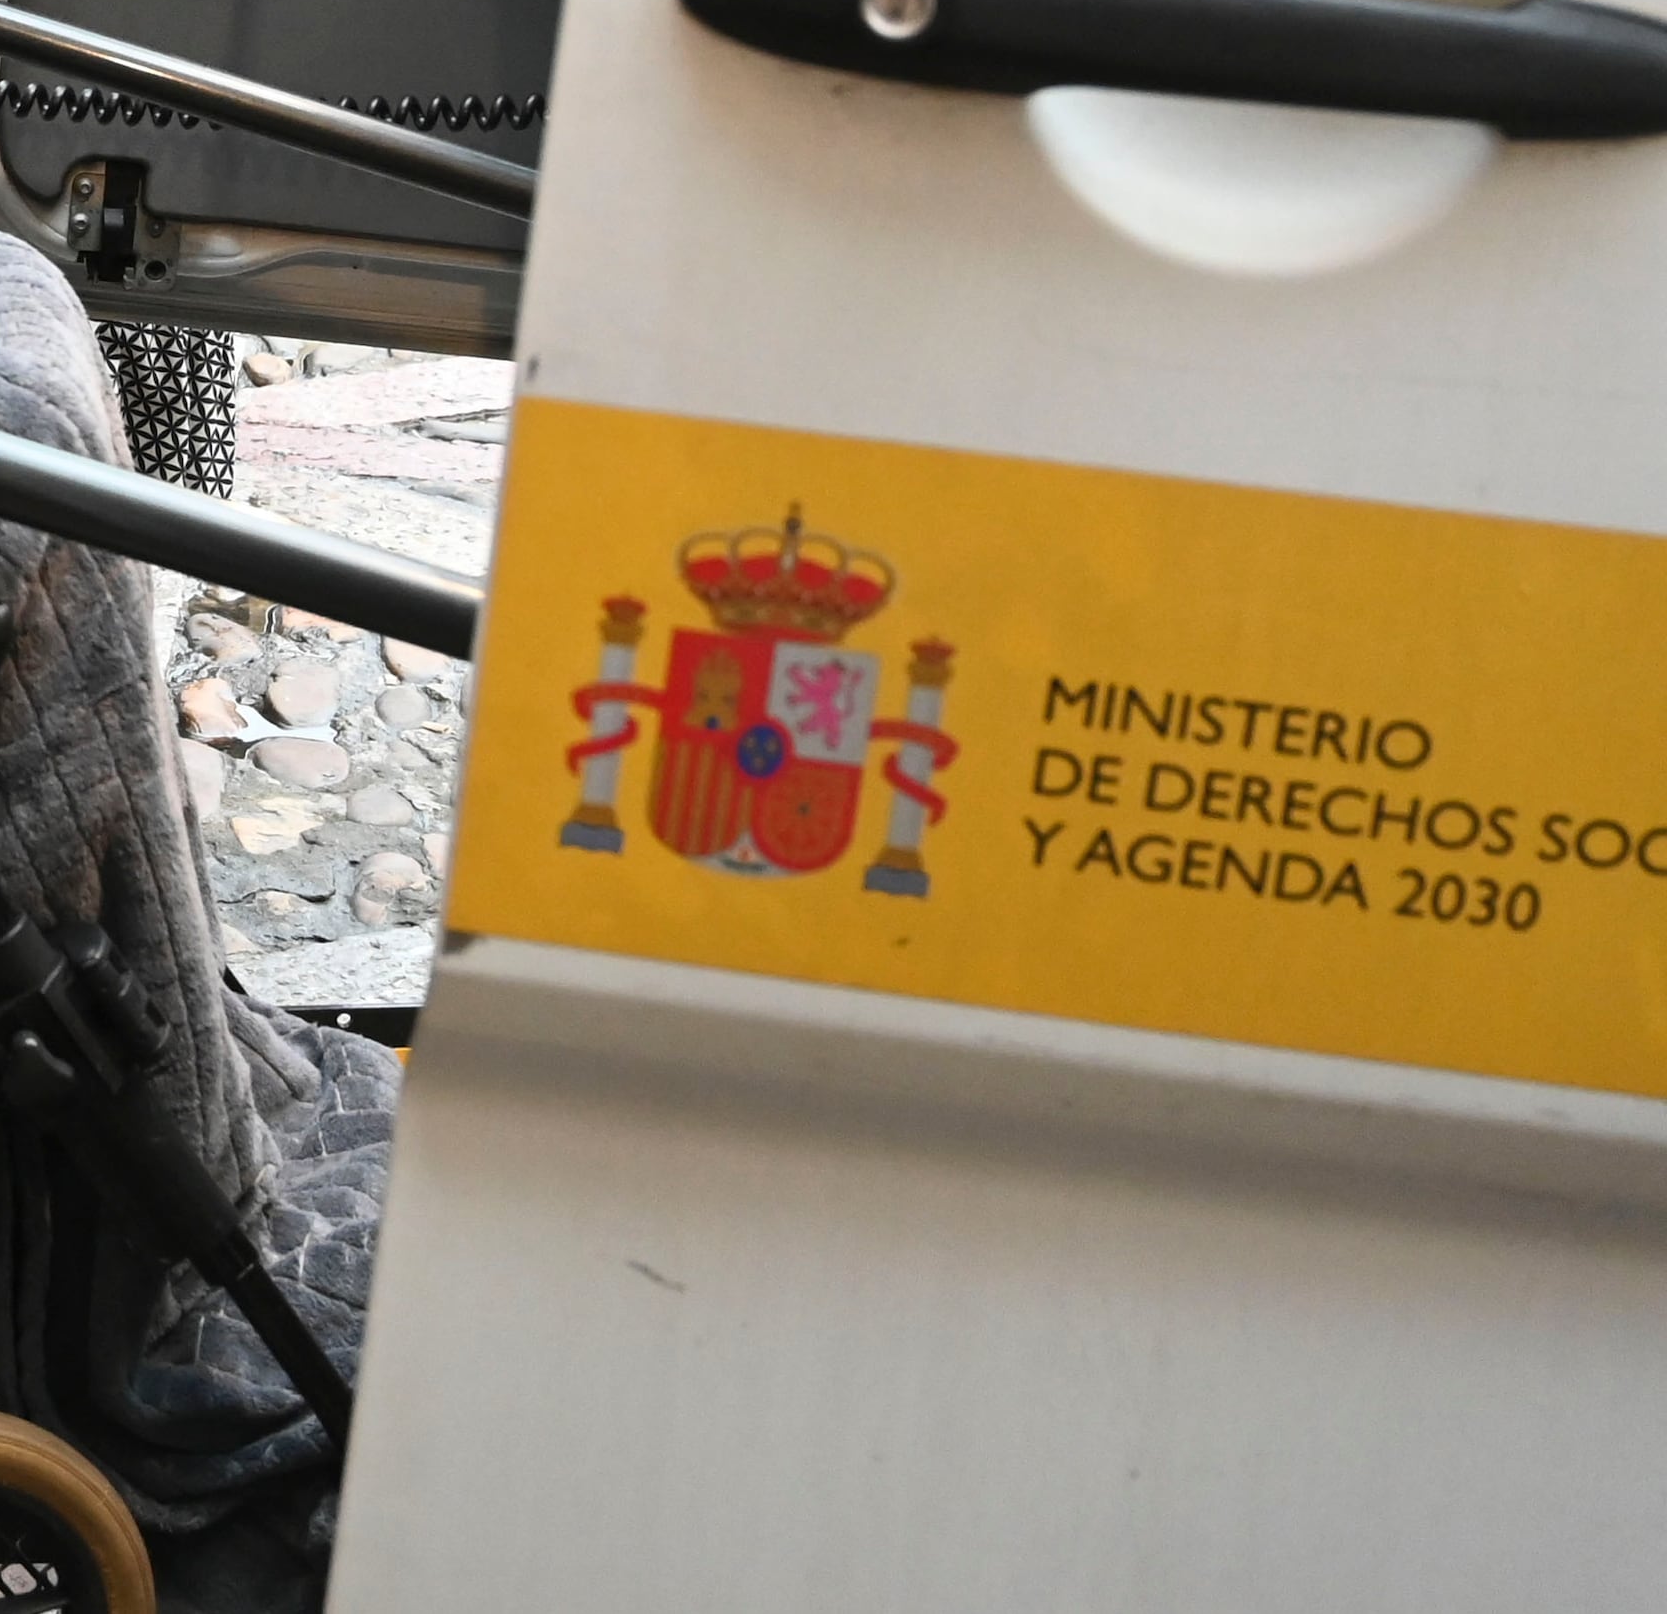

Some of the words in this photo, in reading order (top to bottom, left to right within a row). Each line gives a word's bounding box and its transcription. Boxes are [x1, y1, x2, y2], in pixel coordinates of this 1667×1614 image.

[1041, 677, 1433, 770] MINISTERIO
[1033, 747, 1125, 805] DE
[1144, 761, 1518, 857] DERECHOS
[1023, 816, 1065, 866] Y
[1075, 827, 1369, 911] AGENDA
[1394, 867, 1542, 932] 2030
